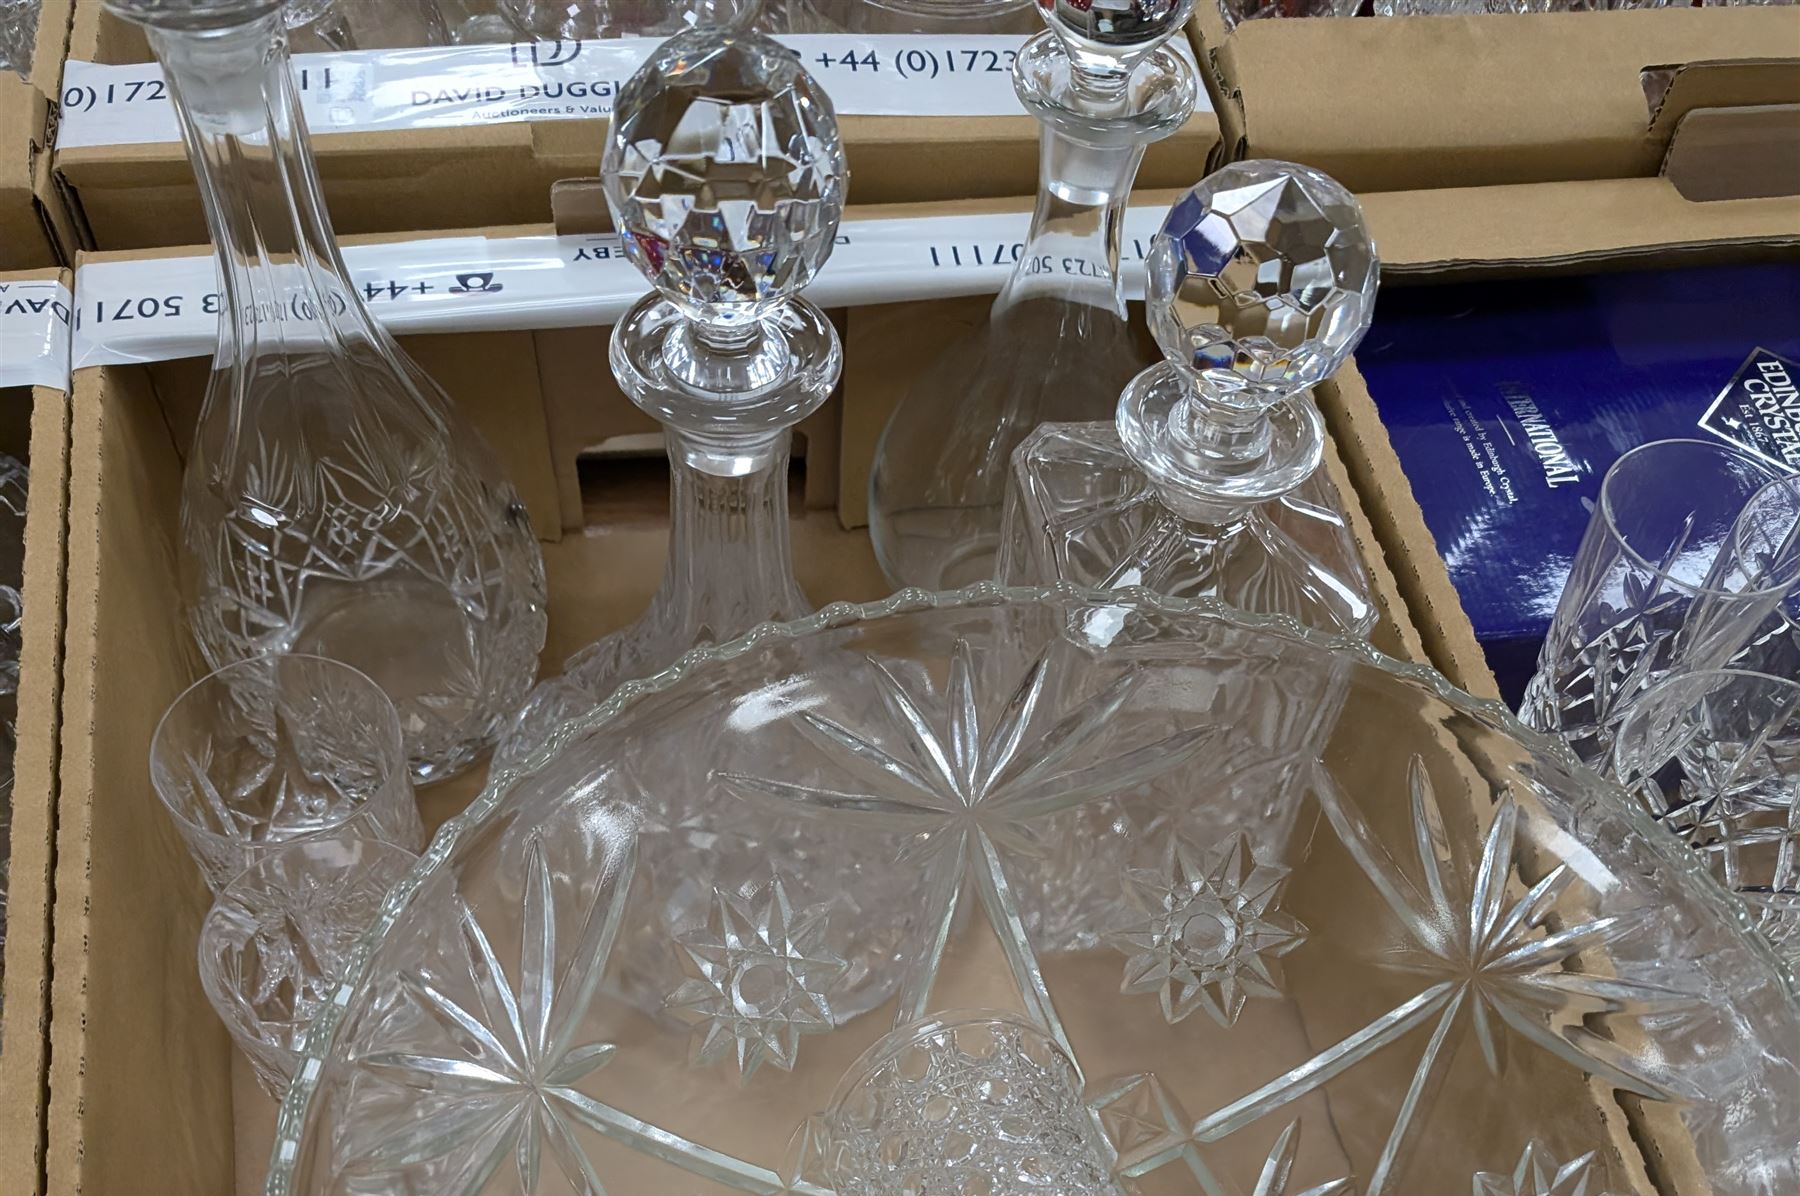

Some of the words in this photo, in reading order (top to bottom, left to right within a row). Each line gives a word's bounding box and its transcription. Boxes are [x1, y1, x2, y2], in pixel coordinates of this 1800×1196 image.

[815, 49, 881, 73] +44
[411, 84, 507, 107] DAVID
[362, 279, 435, 301] +44
[1738, 404, 1754, 419] Est
[1748, 422, 1770, 444] 1867
[1466, 442, 1481, 461] made
[1475, 461, 1484, 469] in
[1480, 470, 1496, 497] Europe.
[1483, 441, 1506, 476] Edinburgh
[1500, 476, 1518, 505] Crystal,
